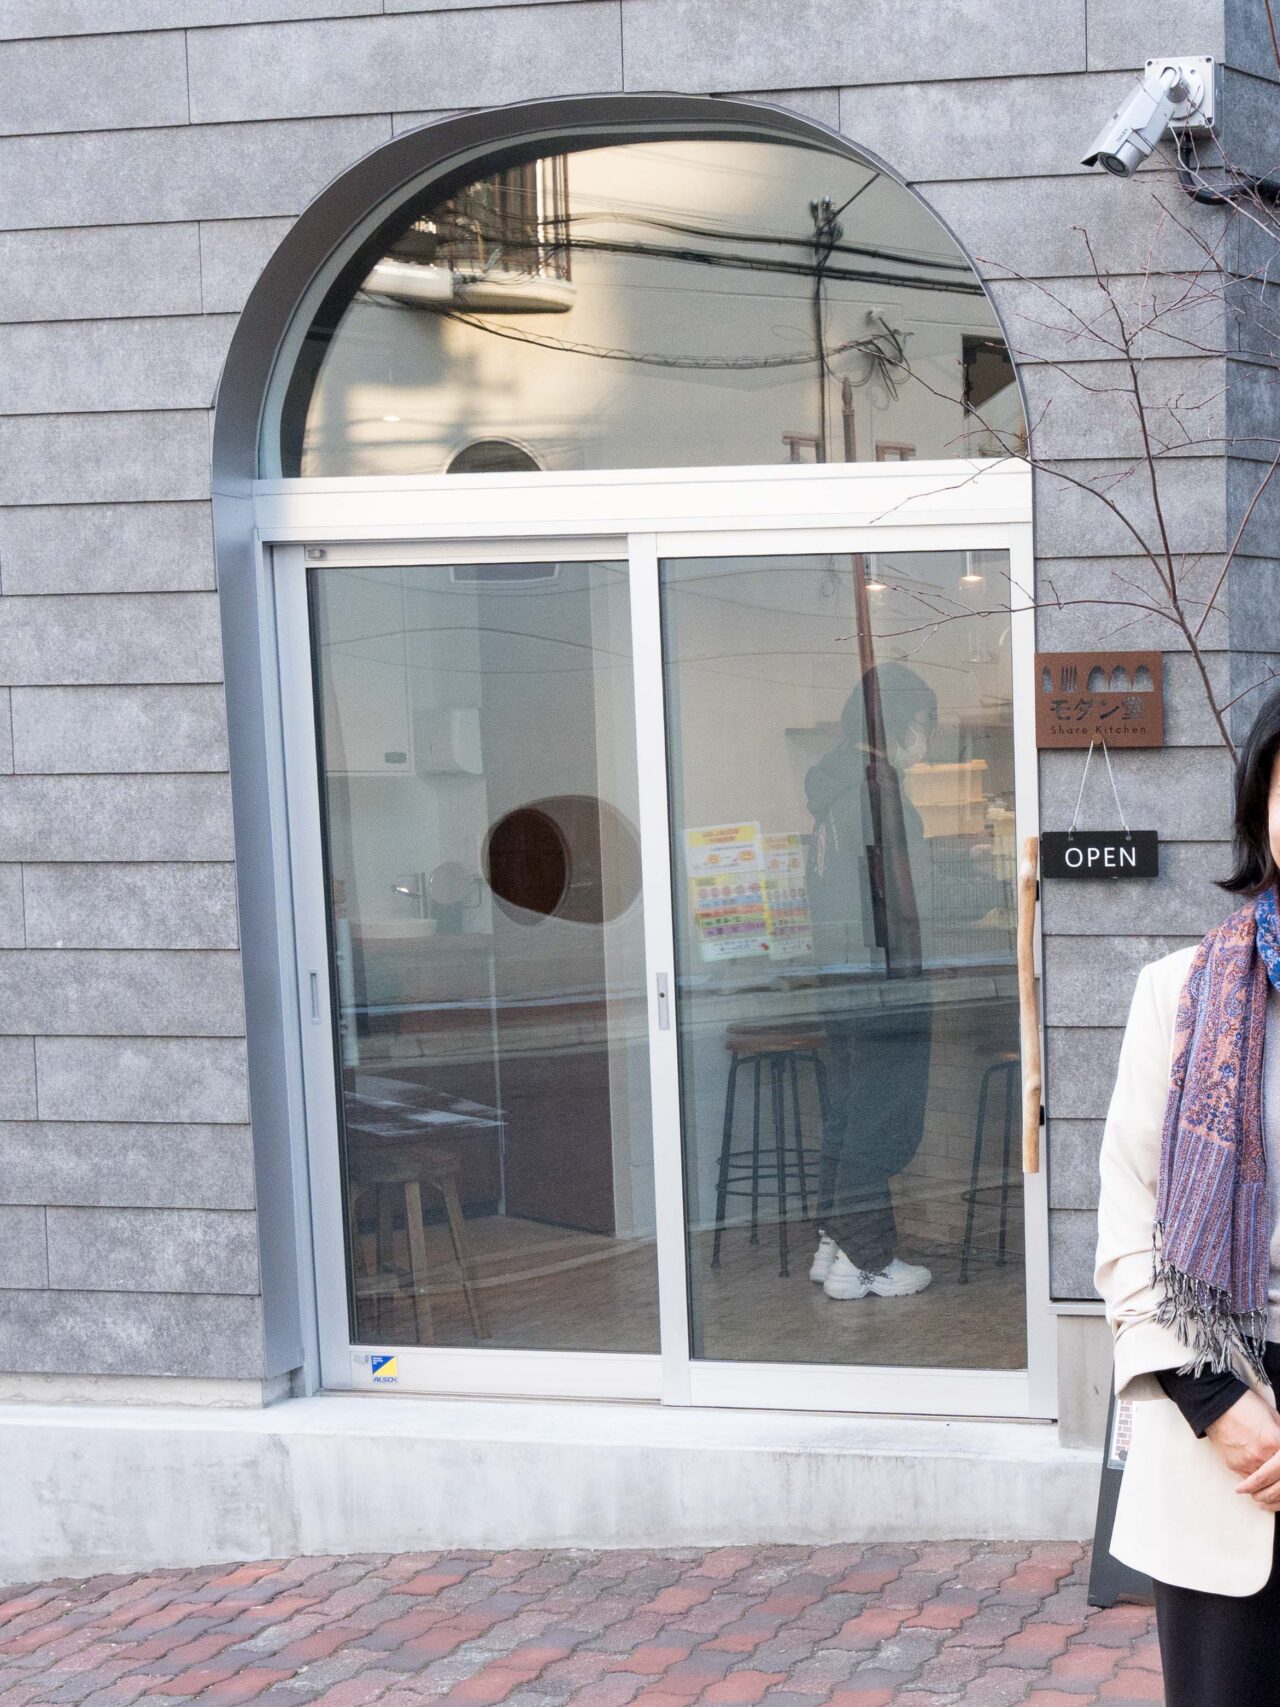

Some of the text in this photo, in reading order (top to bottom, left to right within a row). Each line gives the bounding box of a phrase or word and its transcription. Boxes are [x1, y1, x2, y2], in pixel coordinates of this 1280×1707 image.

[1051, 725, 1146, 735] Share Kitchen
[1064, 846, 1136, 868] OPEN
